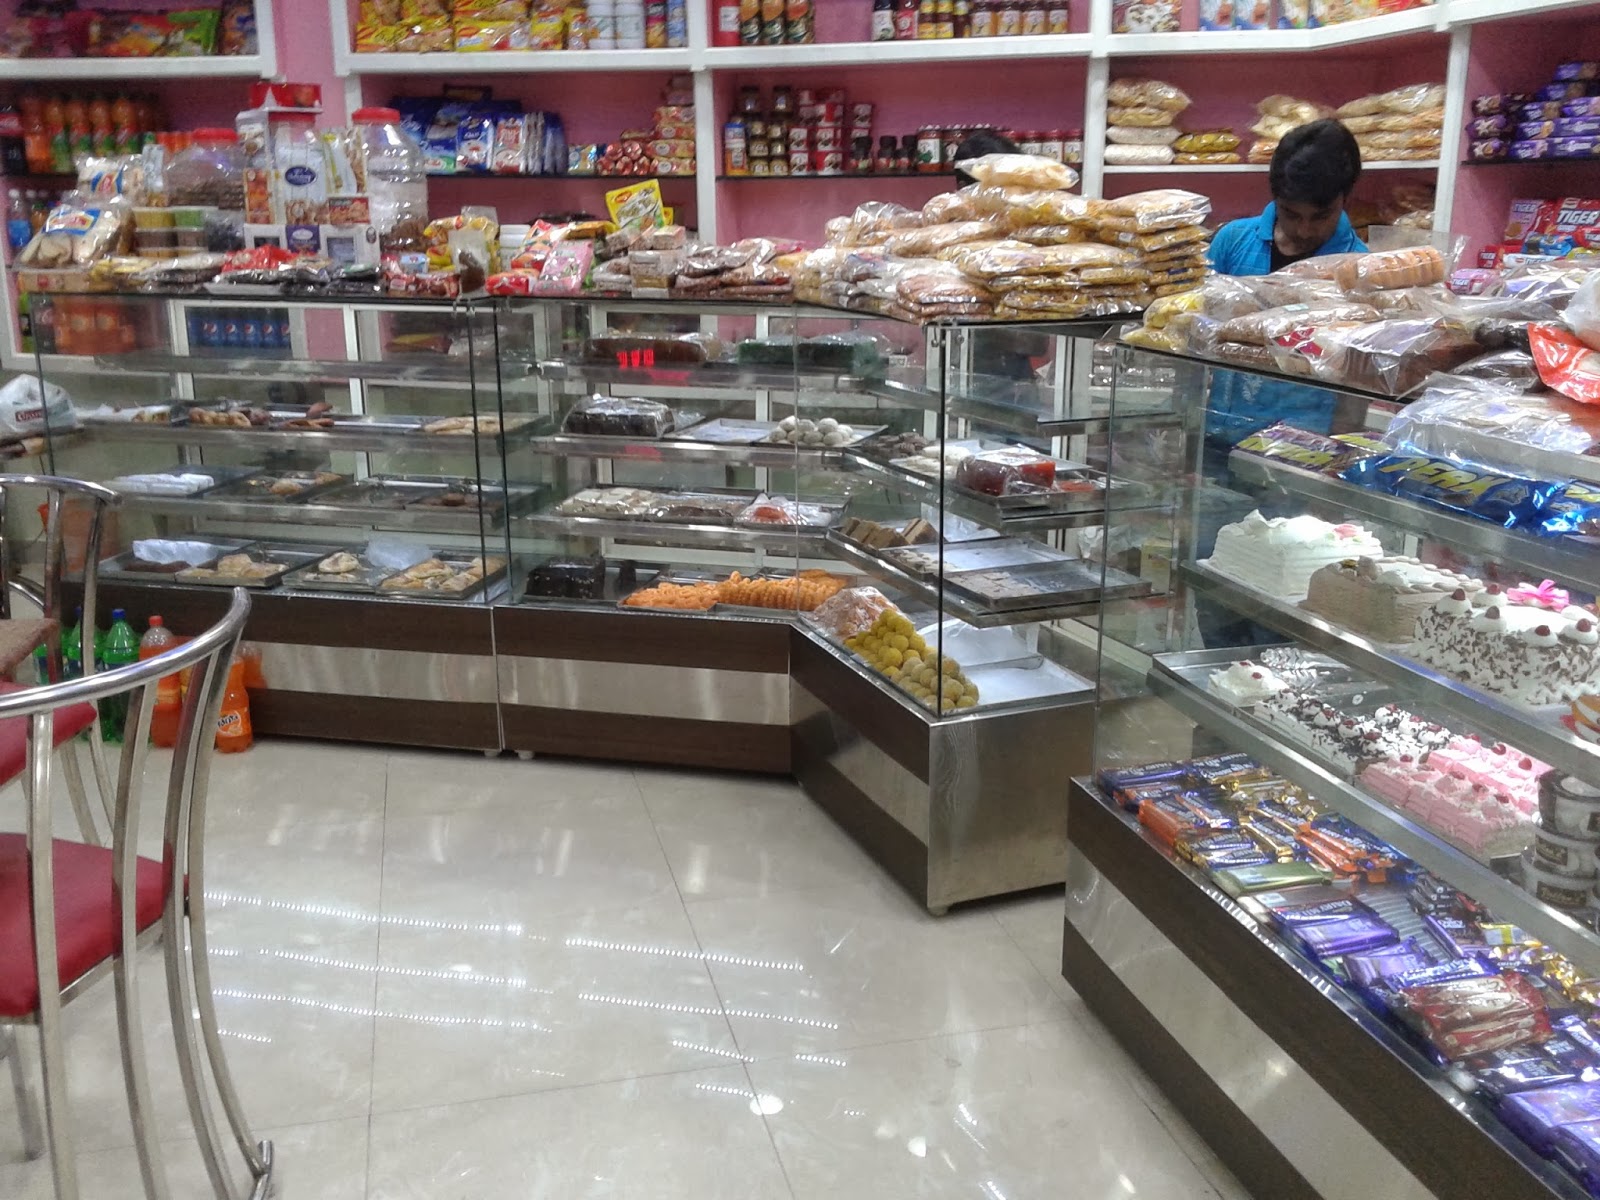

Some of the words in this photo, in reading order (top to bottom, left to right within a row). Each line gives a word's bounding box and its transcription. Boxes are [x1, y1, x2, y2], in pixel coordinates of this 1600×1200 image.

[1513, 203, 1537, 213] TIGER
[1556, 209, 1599, 225] TIGER
[1379, 457, 1515, 497] PERK
